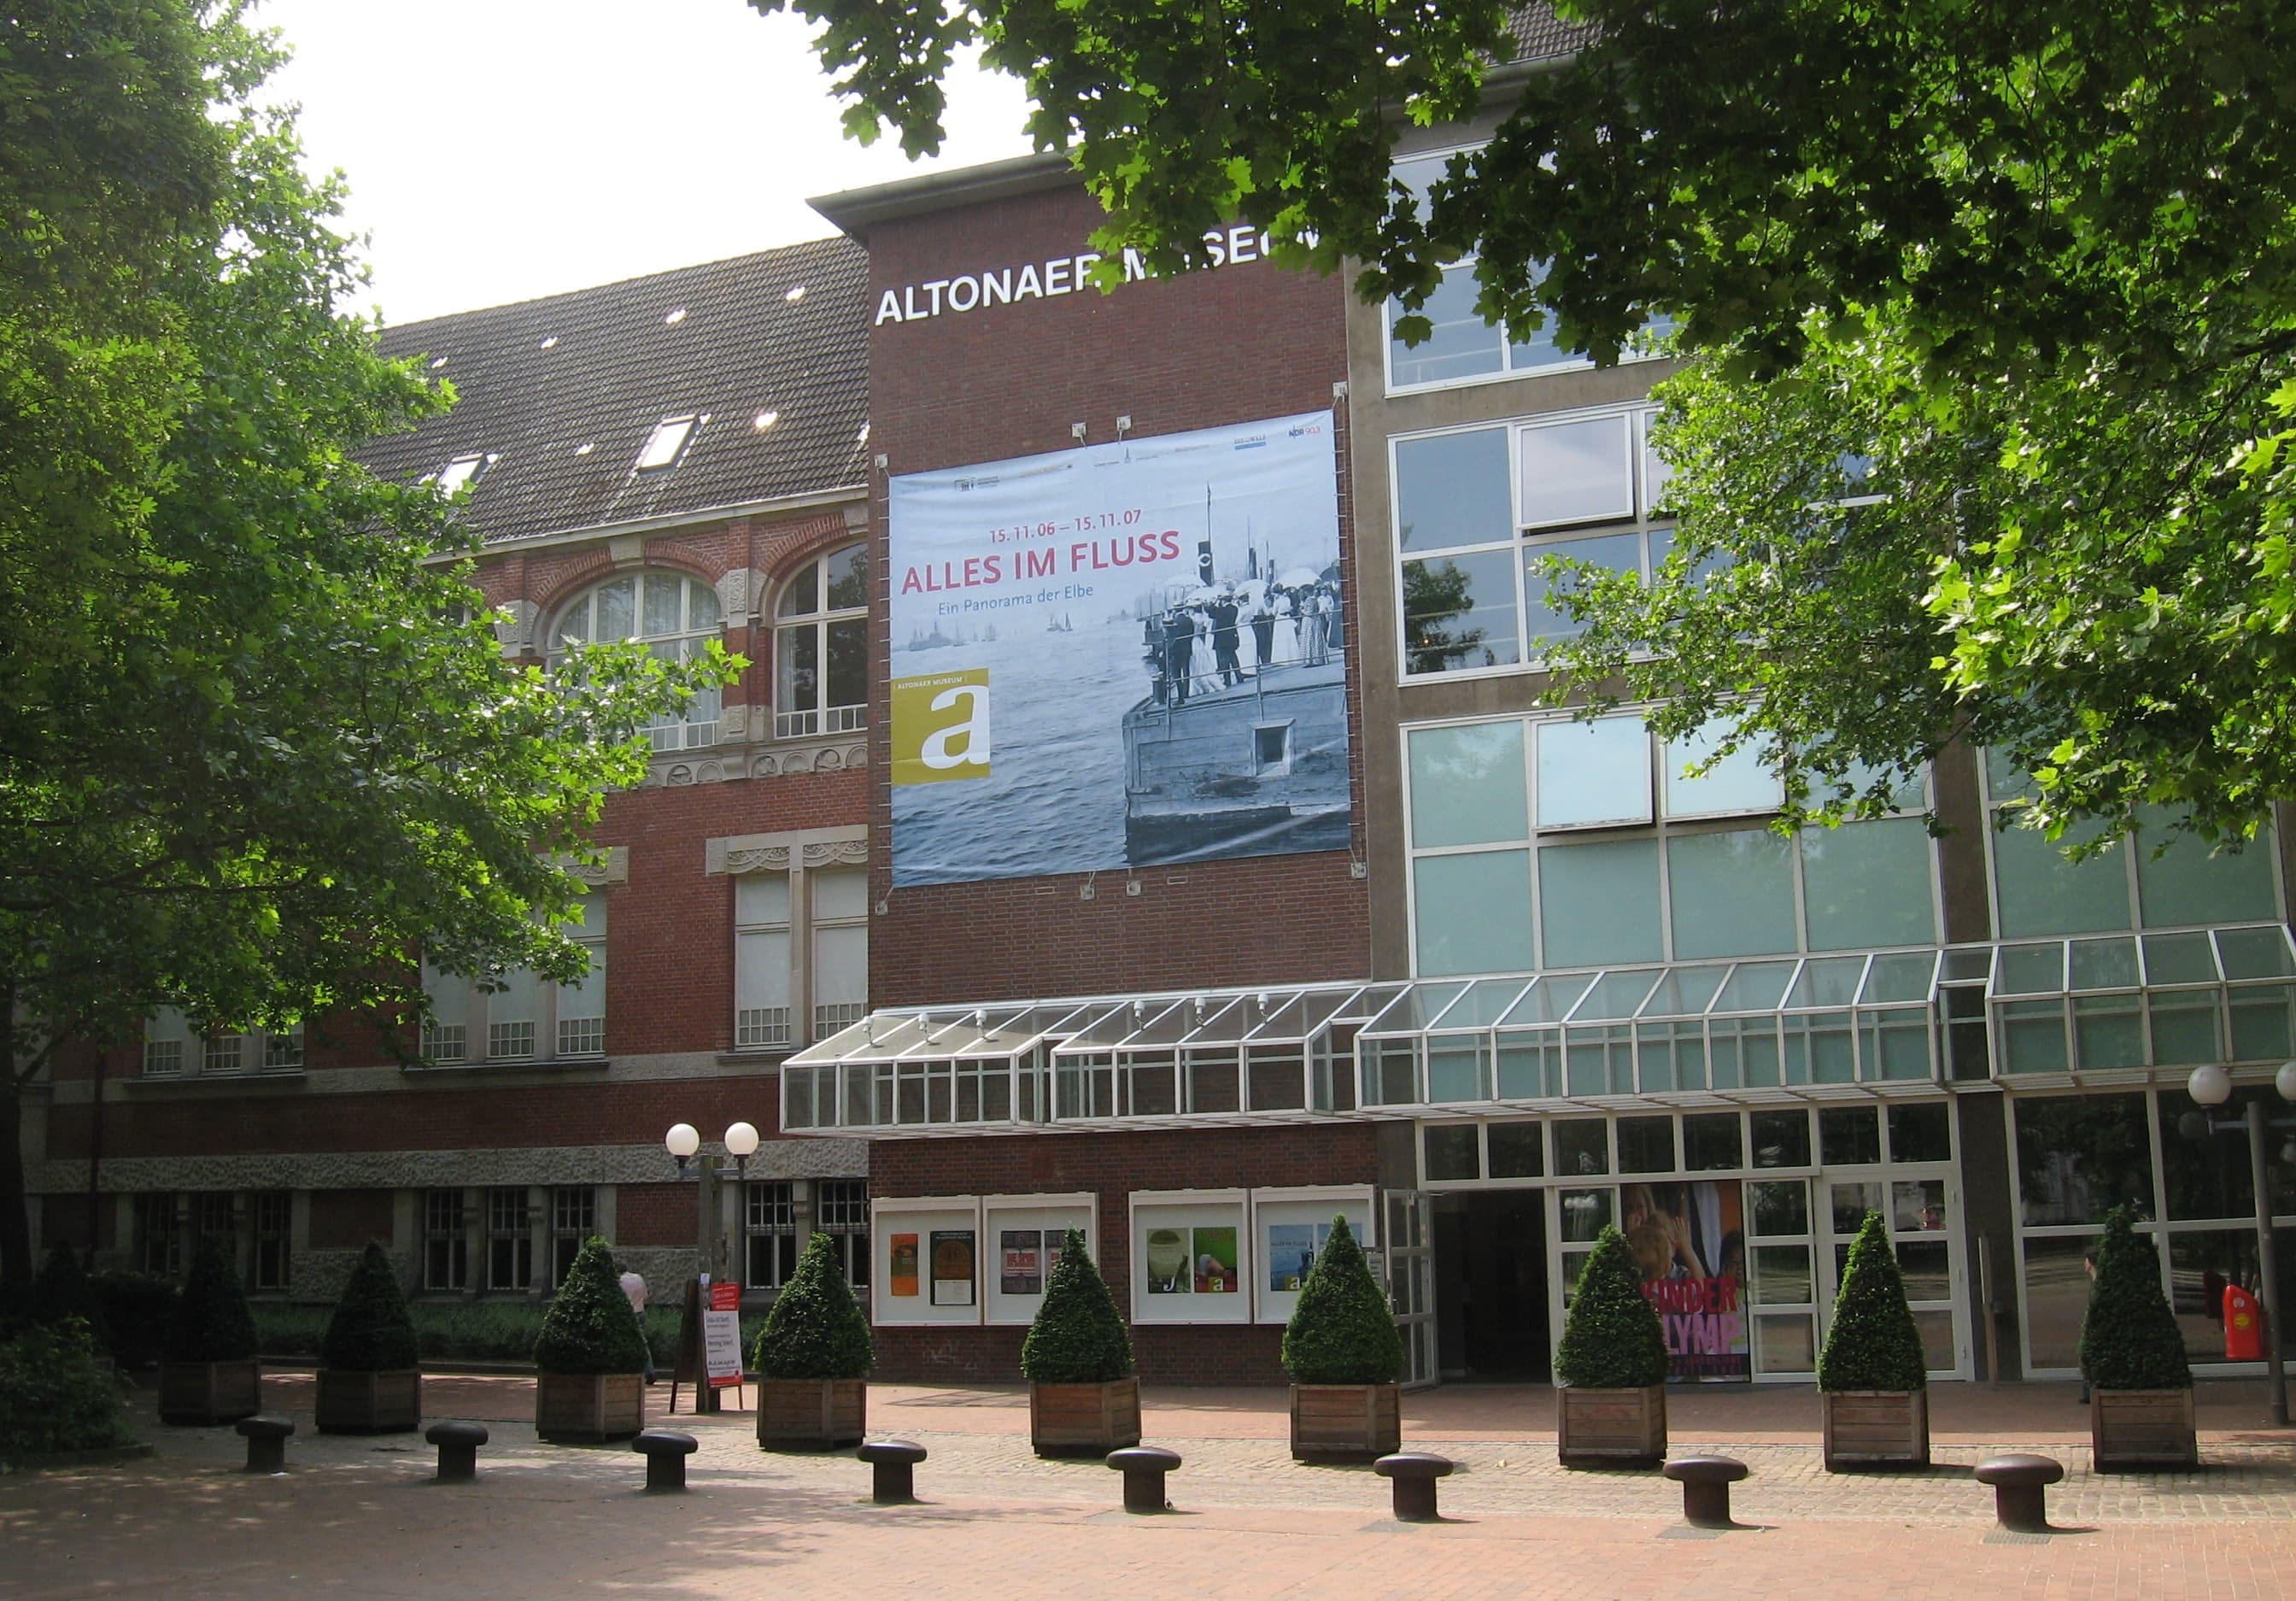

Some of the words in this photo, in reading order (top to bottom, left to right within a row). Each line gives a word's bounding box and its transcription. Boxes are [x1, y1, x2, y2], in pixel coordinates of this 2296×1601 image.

[875, 254, 1102, 326] ALTONAER
[1123, 224, 1321, 283] MSE
[901, 555, 1002, 595] ALLES
[1014, 548, 1056, 581] IM
[1071, 531, 1181, 573] FLUSS
[938, 602, 958, 616] Ein
[964, 593, 1033, 613] Panorama
[1037, 587, 1060, 603] der
[1064, 583, 1094, 600] Elbe
[897, 680, 931, 690] ALTONAER
[933, 676, 964, 686] MUSEUM
[921, 685, 991, 770] a
[1660, 1314, 1740, 1355] LYMP
